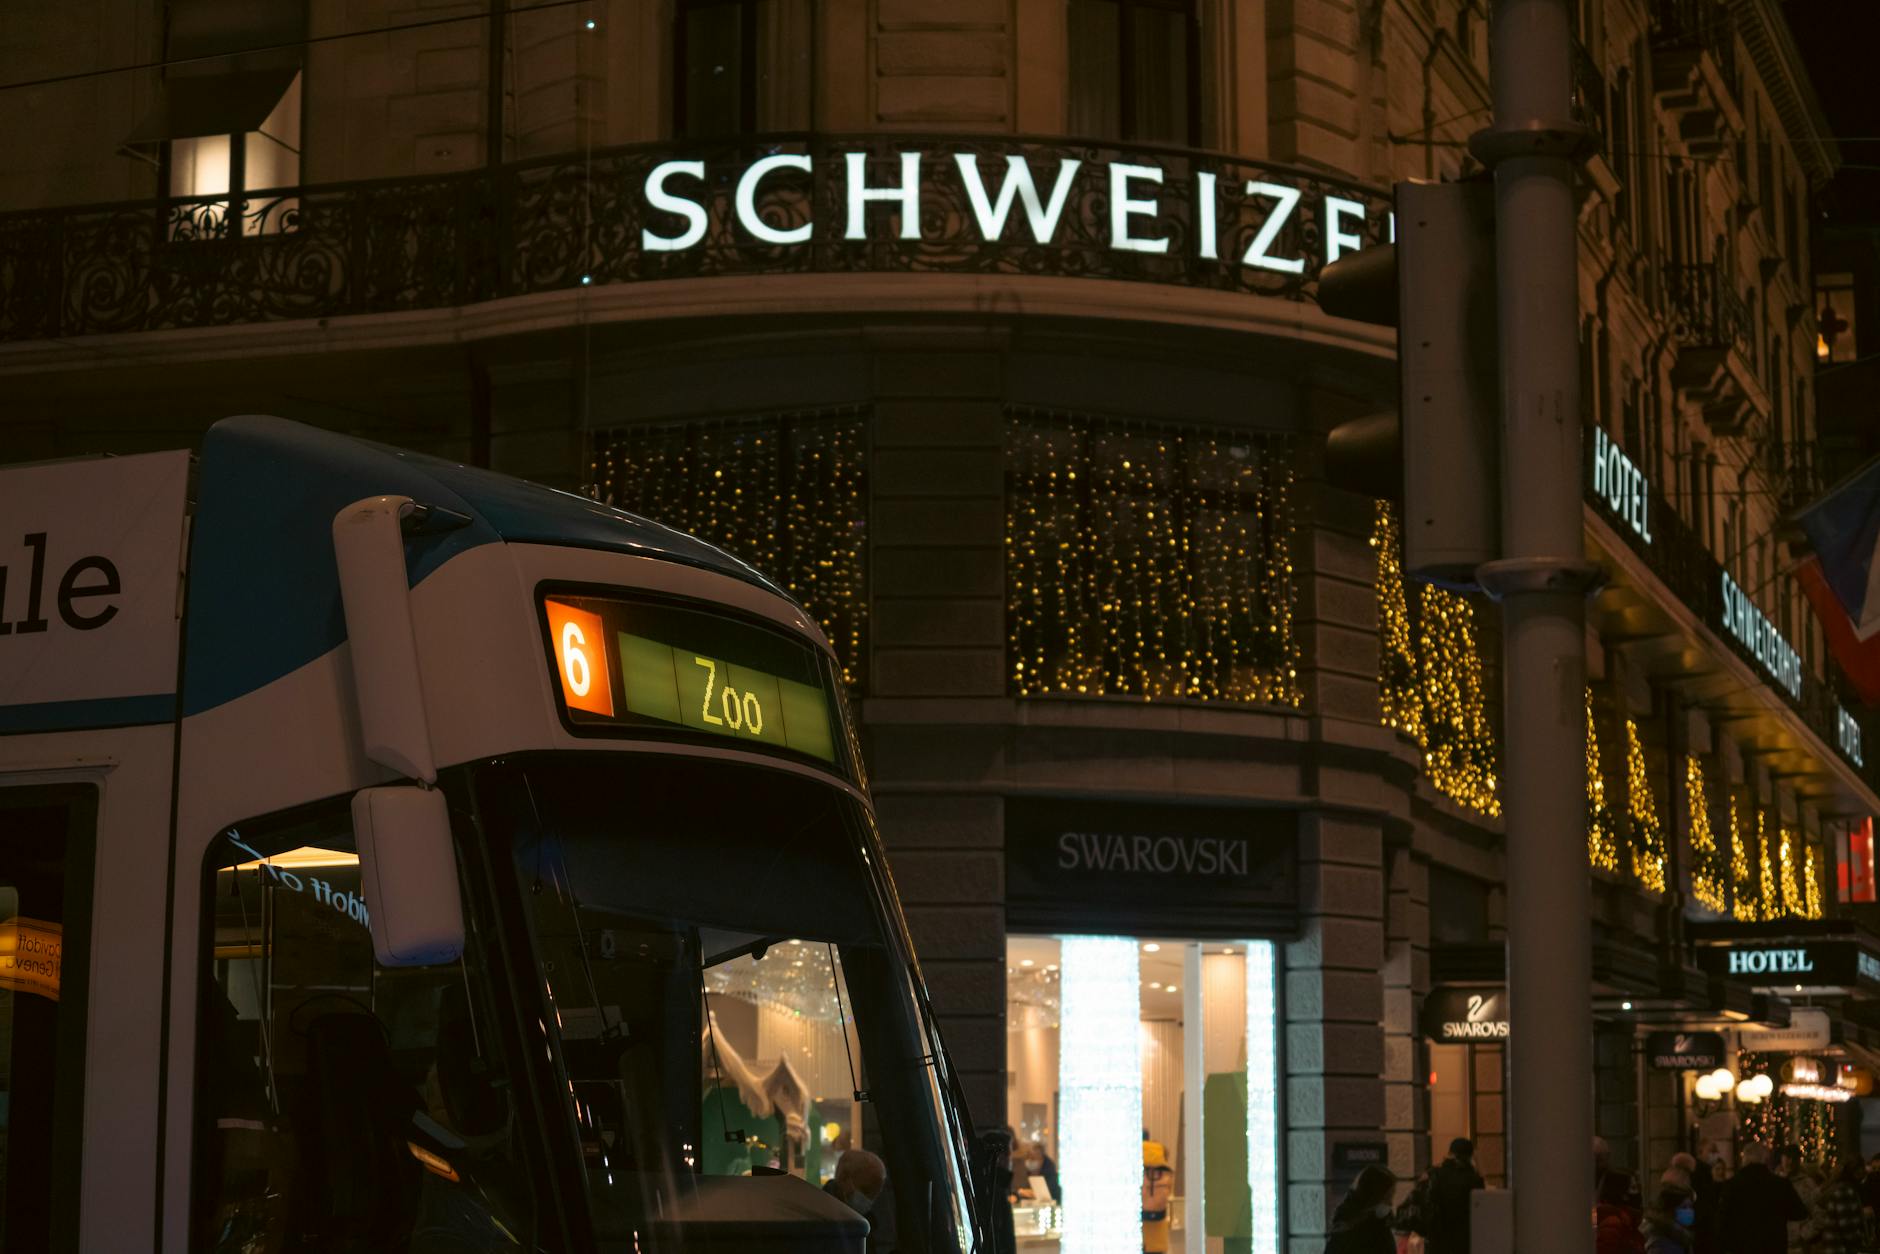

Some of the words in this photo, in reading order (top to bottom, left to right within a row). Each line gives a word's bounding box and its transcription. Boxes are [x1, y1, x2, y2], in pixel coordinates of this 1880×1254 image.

[641, 151, 1396, 275] SCHWEIZE
[1594, 424, 1653, 545] HOTEL
[562, 621, 591, 697] 6
[695, 656, 763, 735] Zoo
[1058, 832, 1249, 876] SWAROVSKI
[1728, 949, 1814, 975] HOTEL
[1442, 1021, 1510, 1038] SWAROVS
